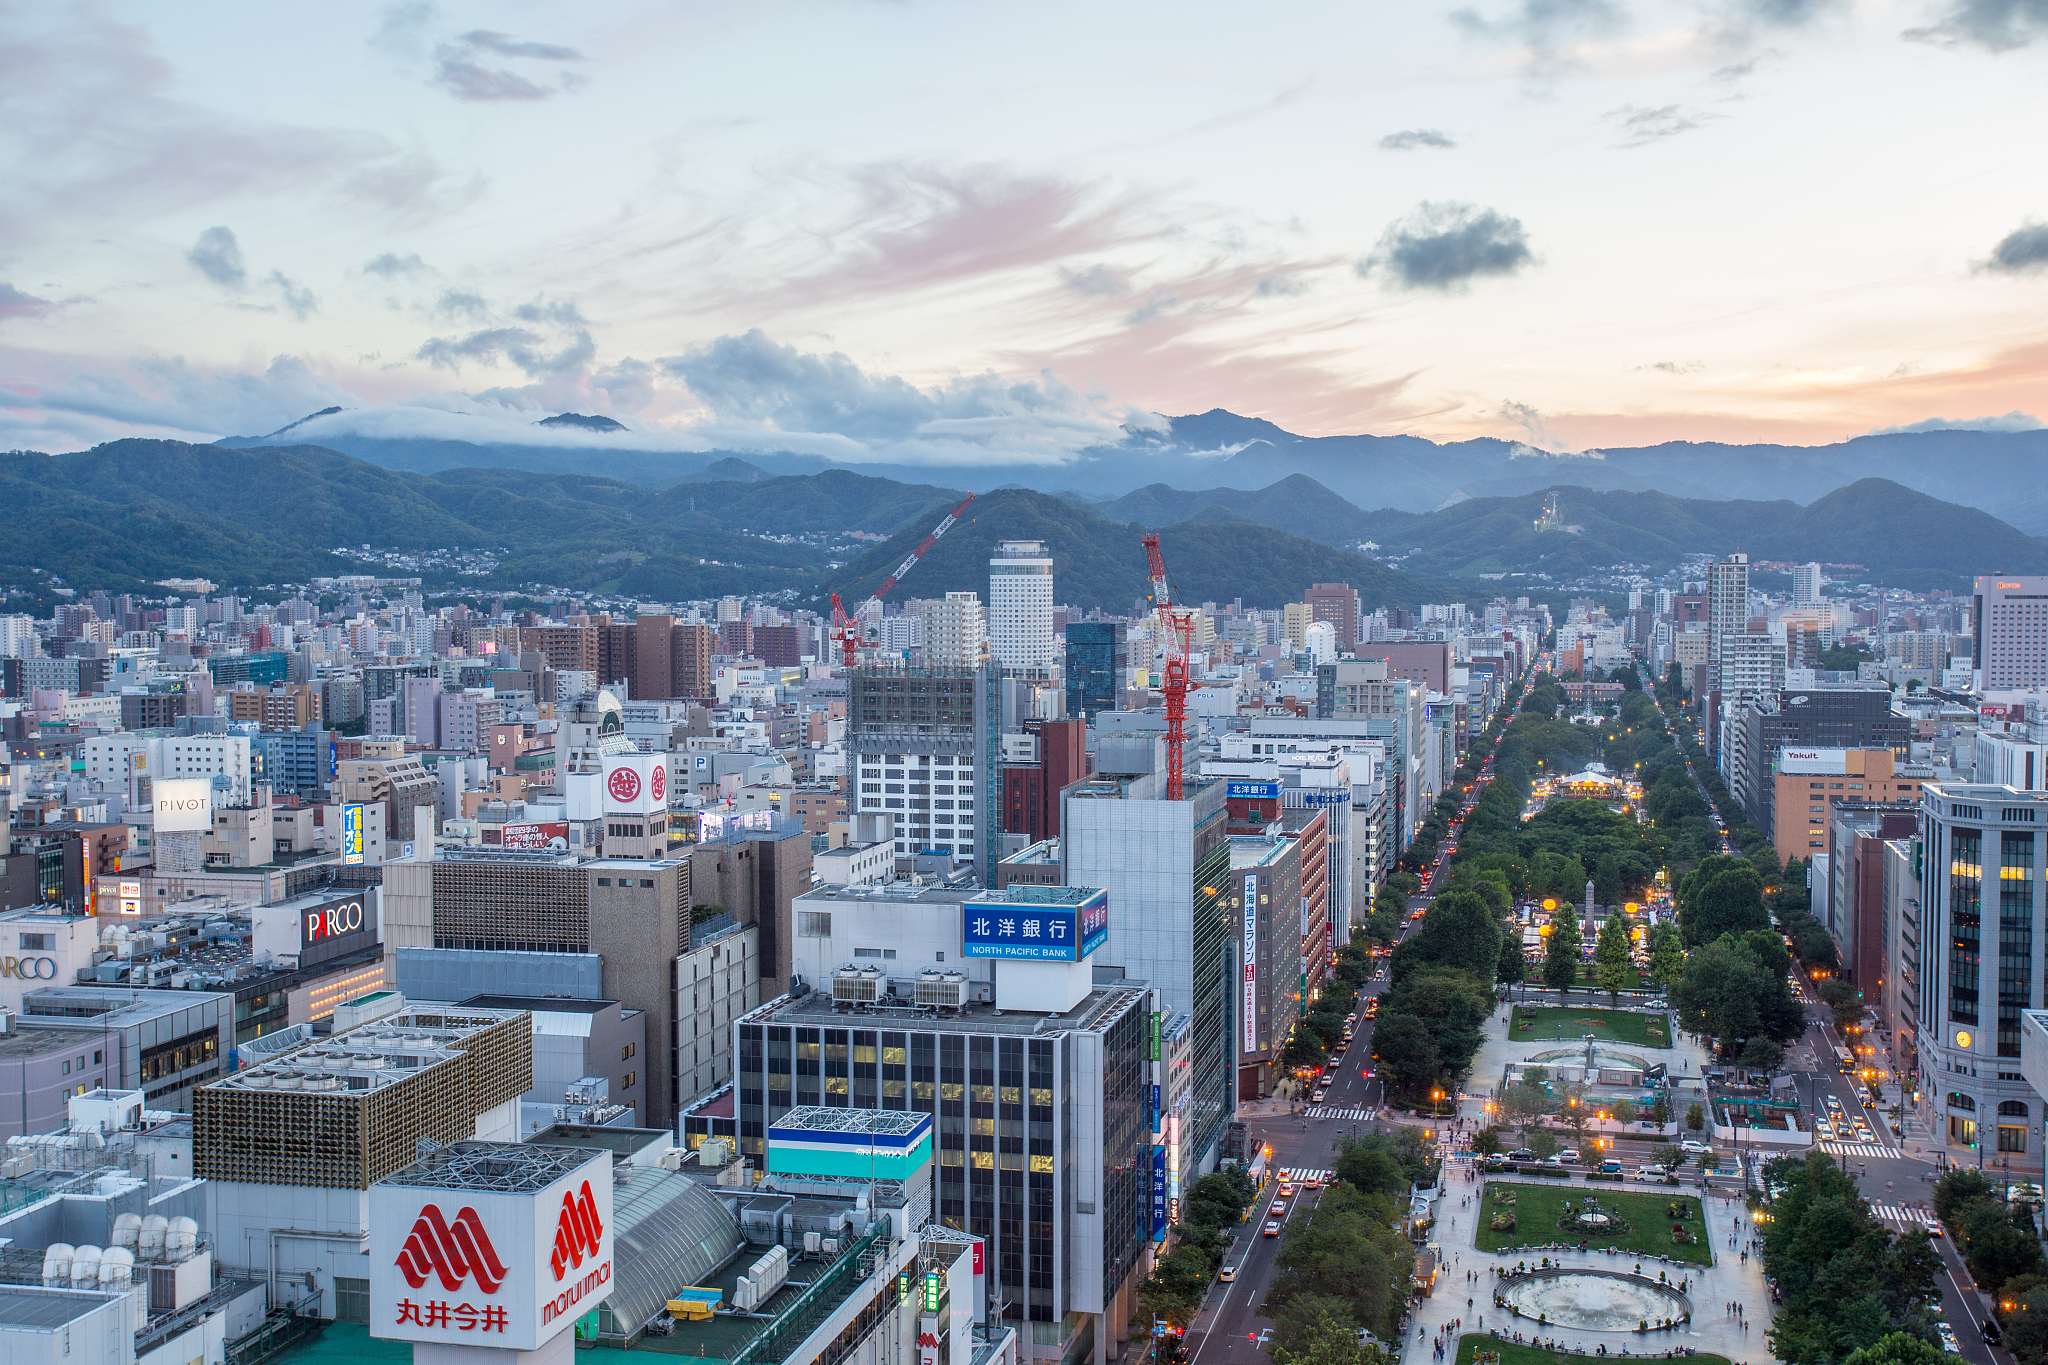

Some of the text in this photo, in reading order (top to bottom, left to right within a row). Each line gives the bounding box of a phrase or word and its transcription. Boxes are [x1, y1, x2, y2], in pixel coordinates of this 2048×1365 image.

[697, 758, 705, 768] P
[1232, 785, 1268, 794] 北洋銀行
[160, 798, 206, 811] PIVOT
[346, 808, 354, 854] イーオン
[405, 845, 411, 856] P
[99, 885, 117, 895] pivot
[308, 902, 362, 941] PARCO
[973, 917, 1067, 939] 北洋銀行
[1083, 905, 1106, 936] 北洋銀行
[1246, 881, 1255, 963] 北海道マラソン
[973, 946, 1067, 957] NORTH PACIFIC BANK
[1154, 1168, 1163, 1218] 北洋銀行
[396, 1297, 509, 1333] 丸井今井
